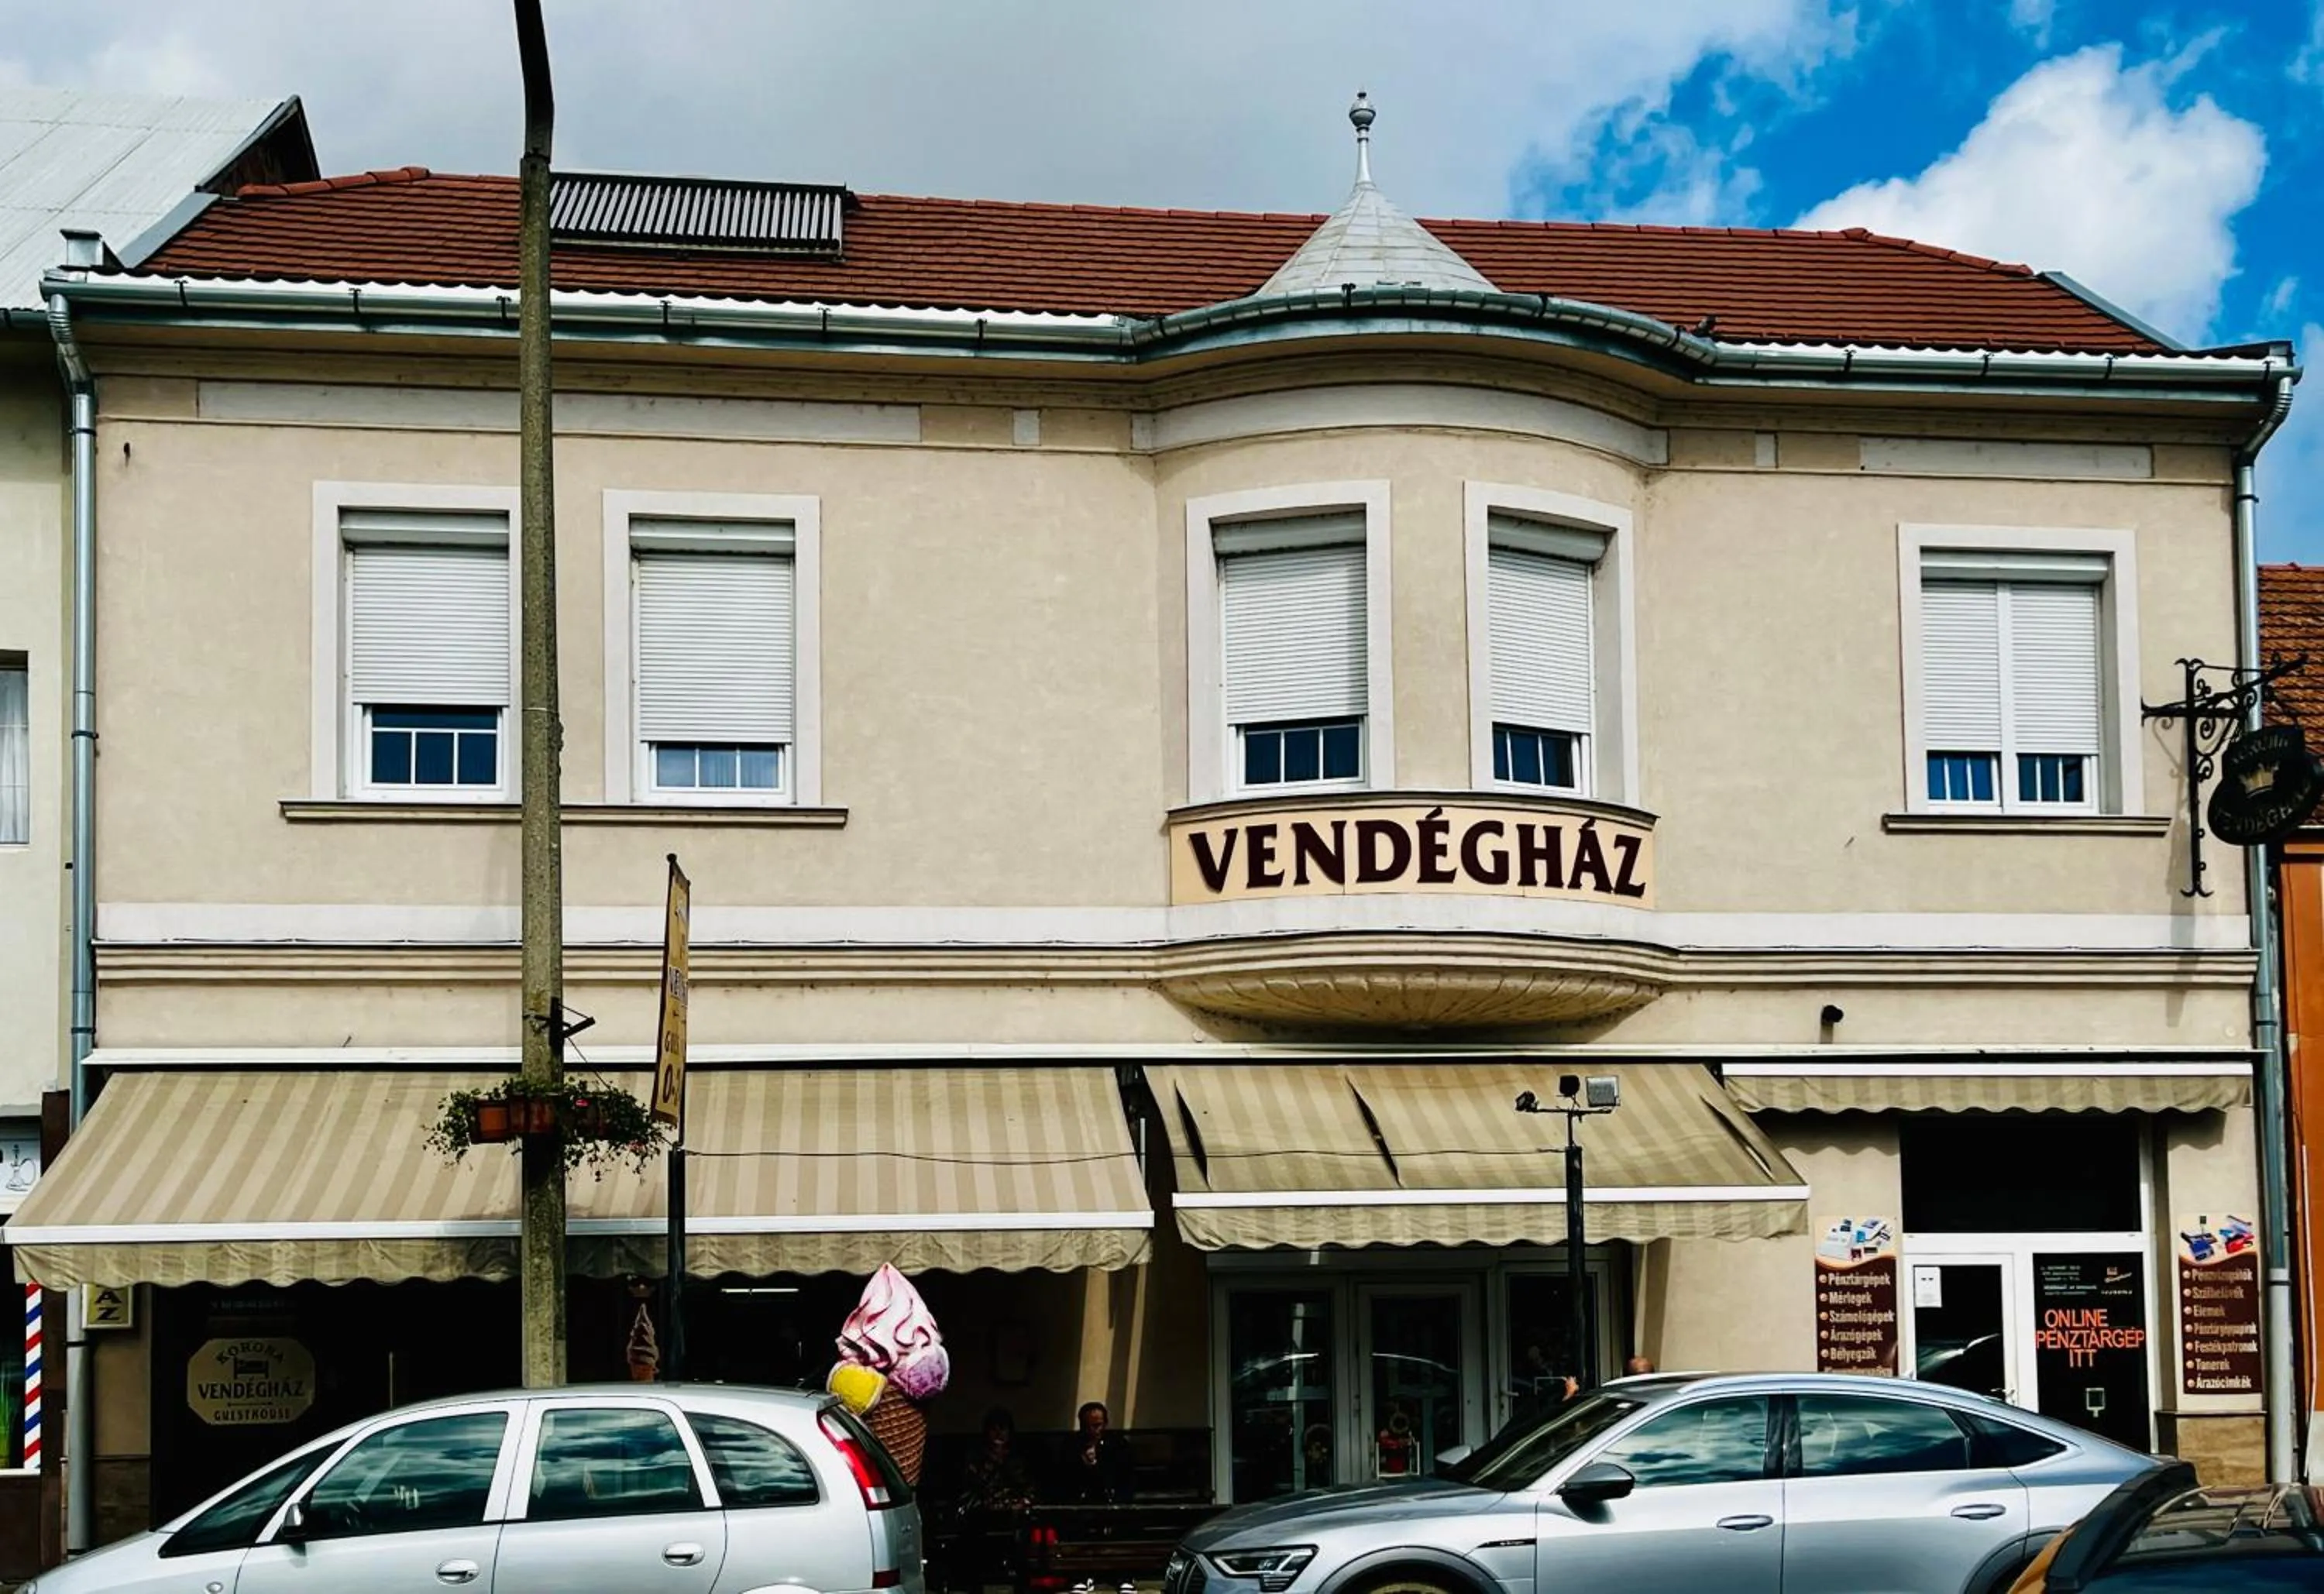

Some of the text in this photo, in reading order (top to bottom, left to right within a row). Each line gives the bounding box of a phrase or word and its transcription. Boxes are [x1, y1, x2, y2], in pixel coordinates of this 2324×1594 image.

[1188, 806, 1646, 898] VENDÉGHÁZ
[2044, 1308, 2109, 1328] ONLINE
[215, 1342, 284, 1365] KORONA
[2069, 1348, 2097, 1368] ITT
[198, 1376, 305, 1400] VENDÉGHÁZ
[214, 1408, 290, 1421] GUESTHOUSE
